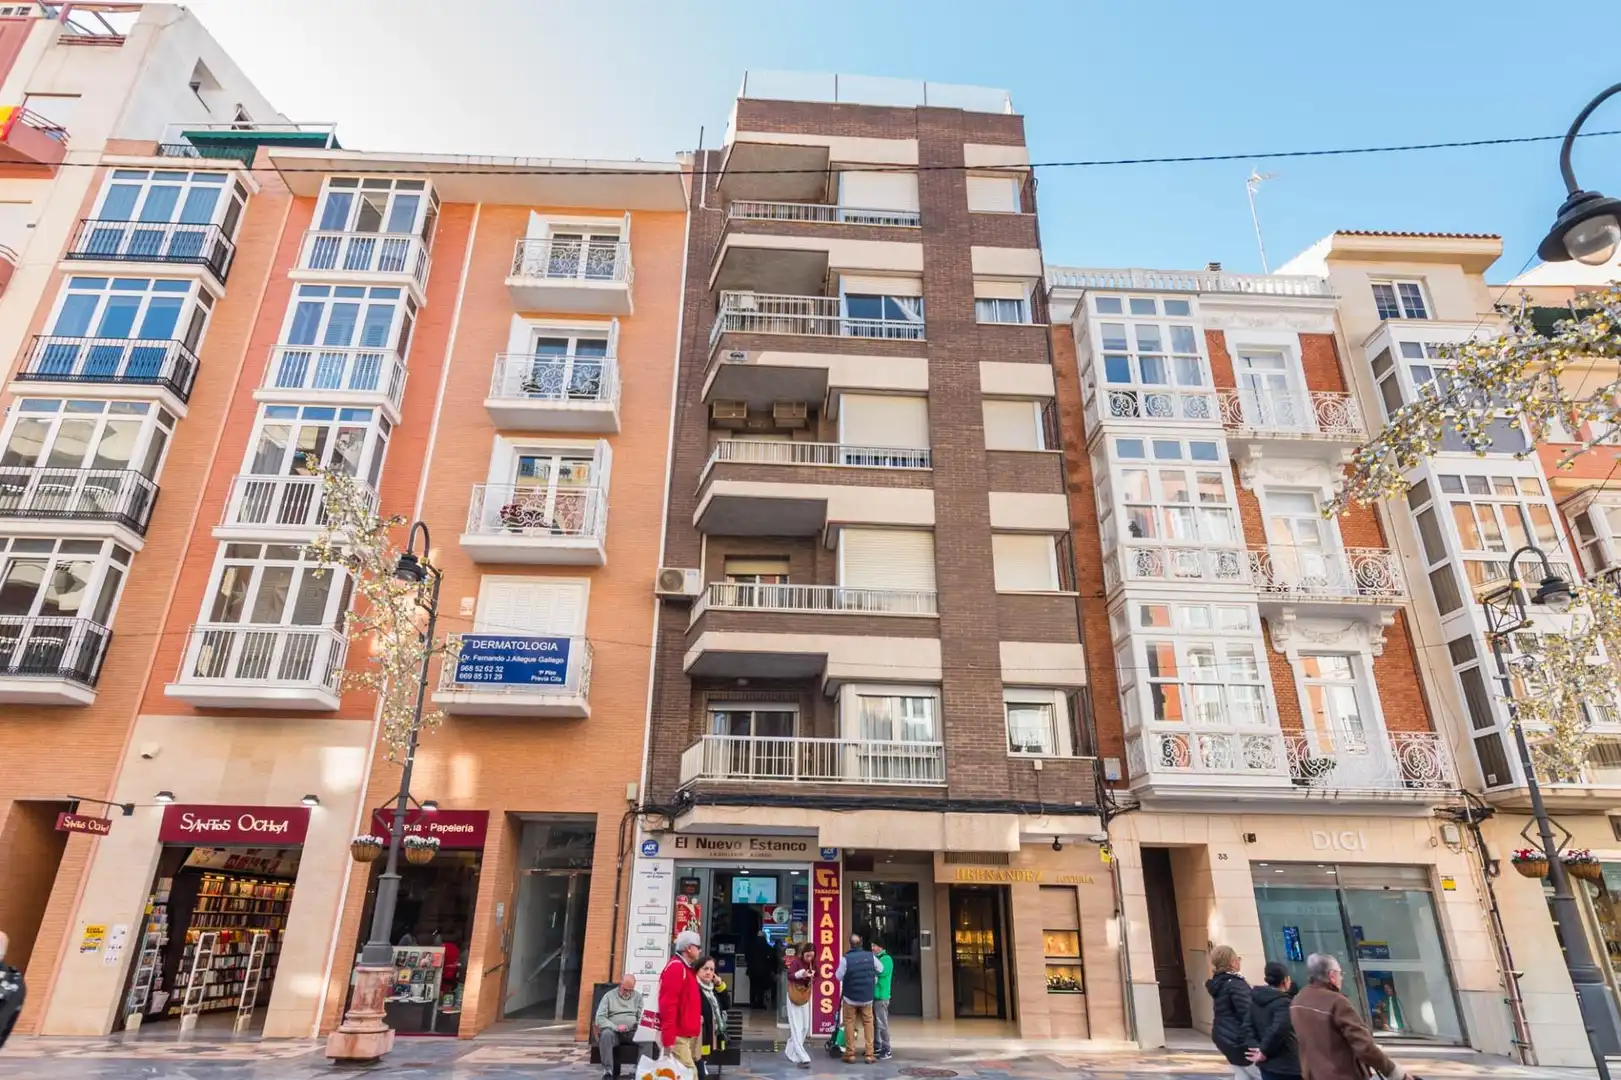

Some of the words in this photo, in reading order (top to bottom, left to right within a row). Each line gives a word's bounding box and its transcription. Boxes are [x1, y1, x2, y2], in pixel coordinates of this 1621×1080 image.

[472, 640, 558, 651] DERMATOLOGIA
[430, 822, 475, 834] Papelería
[675, 836, 688, 849] El
[696, 837, 742, 850] Nuevo
[750, 838, 807, 852] Estanco
[1311, 830, 1366, 852] DIGI
[1217, 853, 1228, 861] 33
[820, 897, 835, 1013] TABACOS
